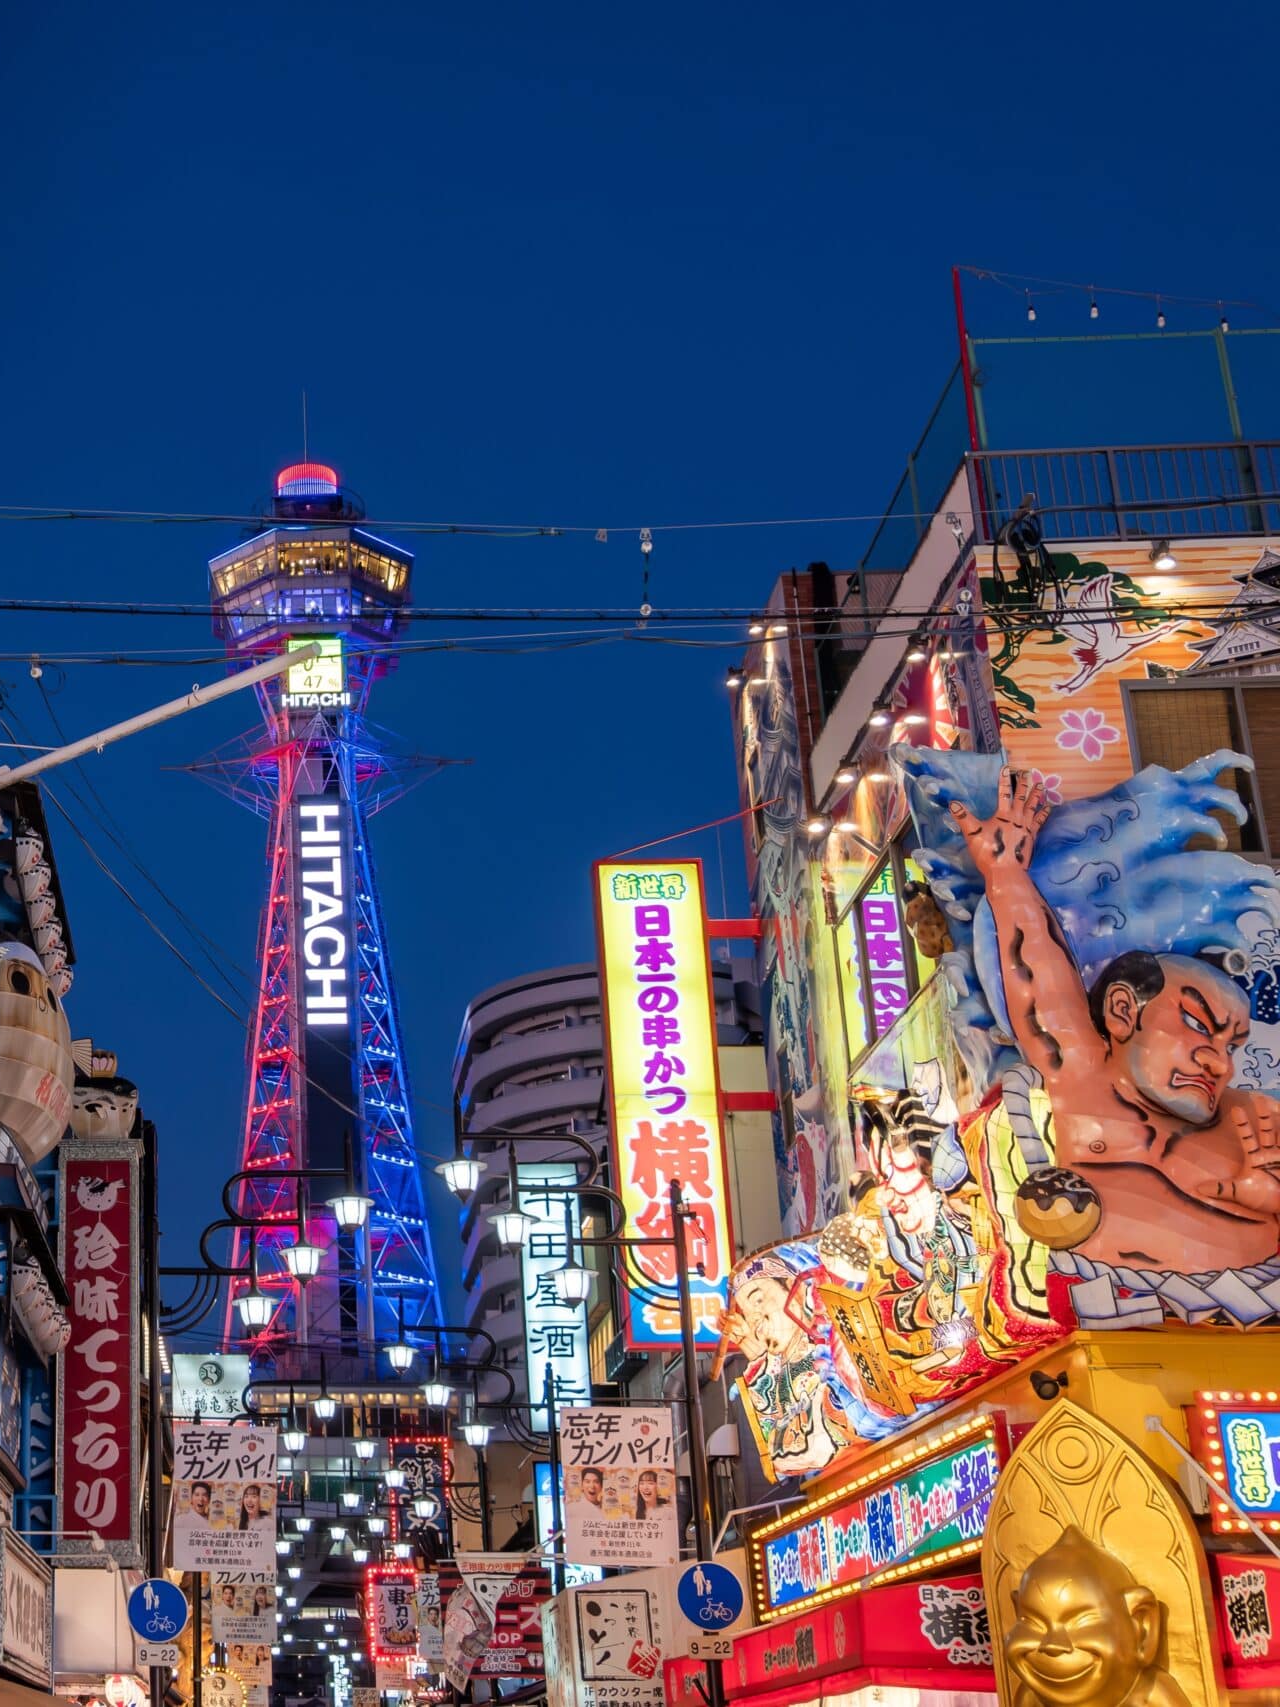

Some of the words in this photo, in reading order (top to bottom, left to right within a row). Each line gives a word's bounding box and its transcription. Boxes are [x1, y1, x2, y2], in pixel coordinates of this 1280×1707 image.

[303, 674, 323, 688] 47
[281, 692, 351, 708] HITACHI
[613, 872, 686, 901] 新世界
[299, 804, 348, 1026] HITACHI
[633, 904, 688, 1115] 日本一の串かつ
[629, 1119, 720, 1284] 横綱
[561, 1412, 622, 1440] 忘年
[175, 1430, 231, 1457] 忘年
[1231, 1422, 1270, 1503] 新世界
[582, 1520, 659, 1530] ジムビームは新世界での
[922, 1587, 985, 1602] 日本一の
[387, 1587, 409, 1632] 串カツ
[490, 1632, 521, 1644] HOP
